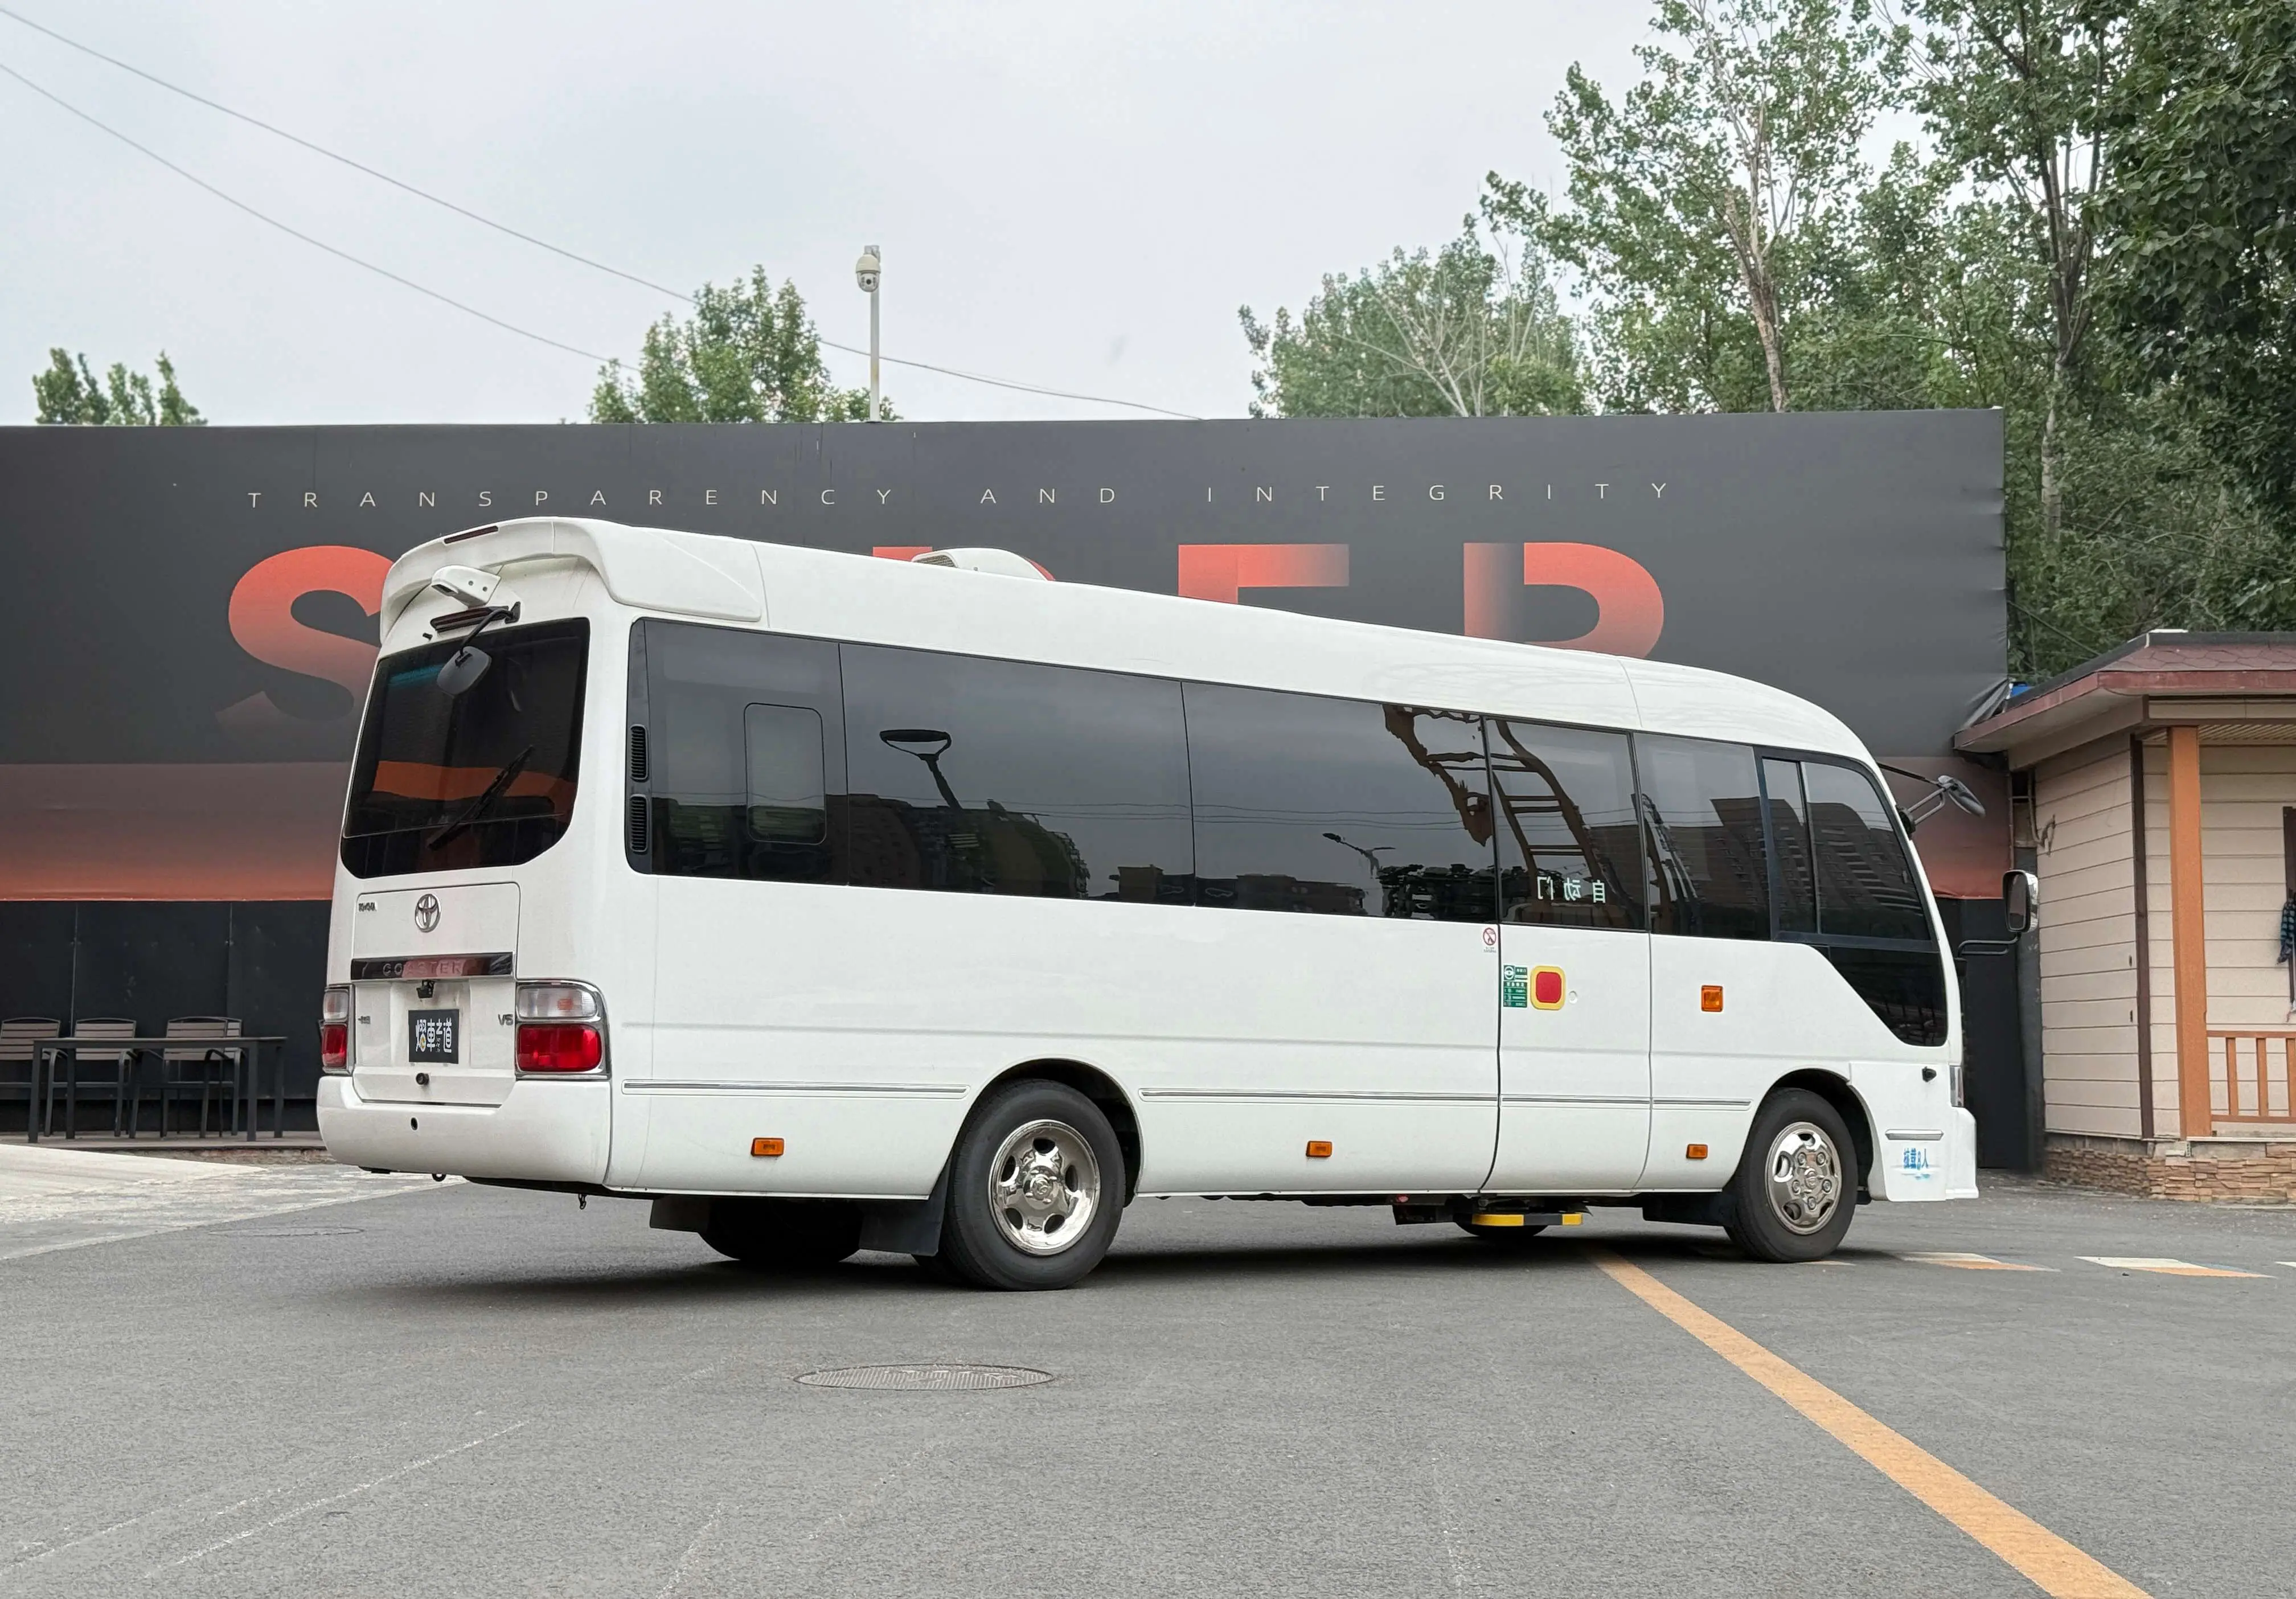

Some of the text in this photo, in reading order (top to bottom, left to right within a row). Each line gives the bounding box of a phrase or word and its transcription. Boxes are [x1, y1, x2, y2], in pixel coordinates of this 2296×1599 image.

[248, 482, 1666, 508] TRANSPARENCY AND INTEGRITY
[382, 960, 463, 977] COASTER
